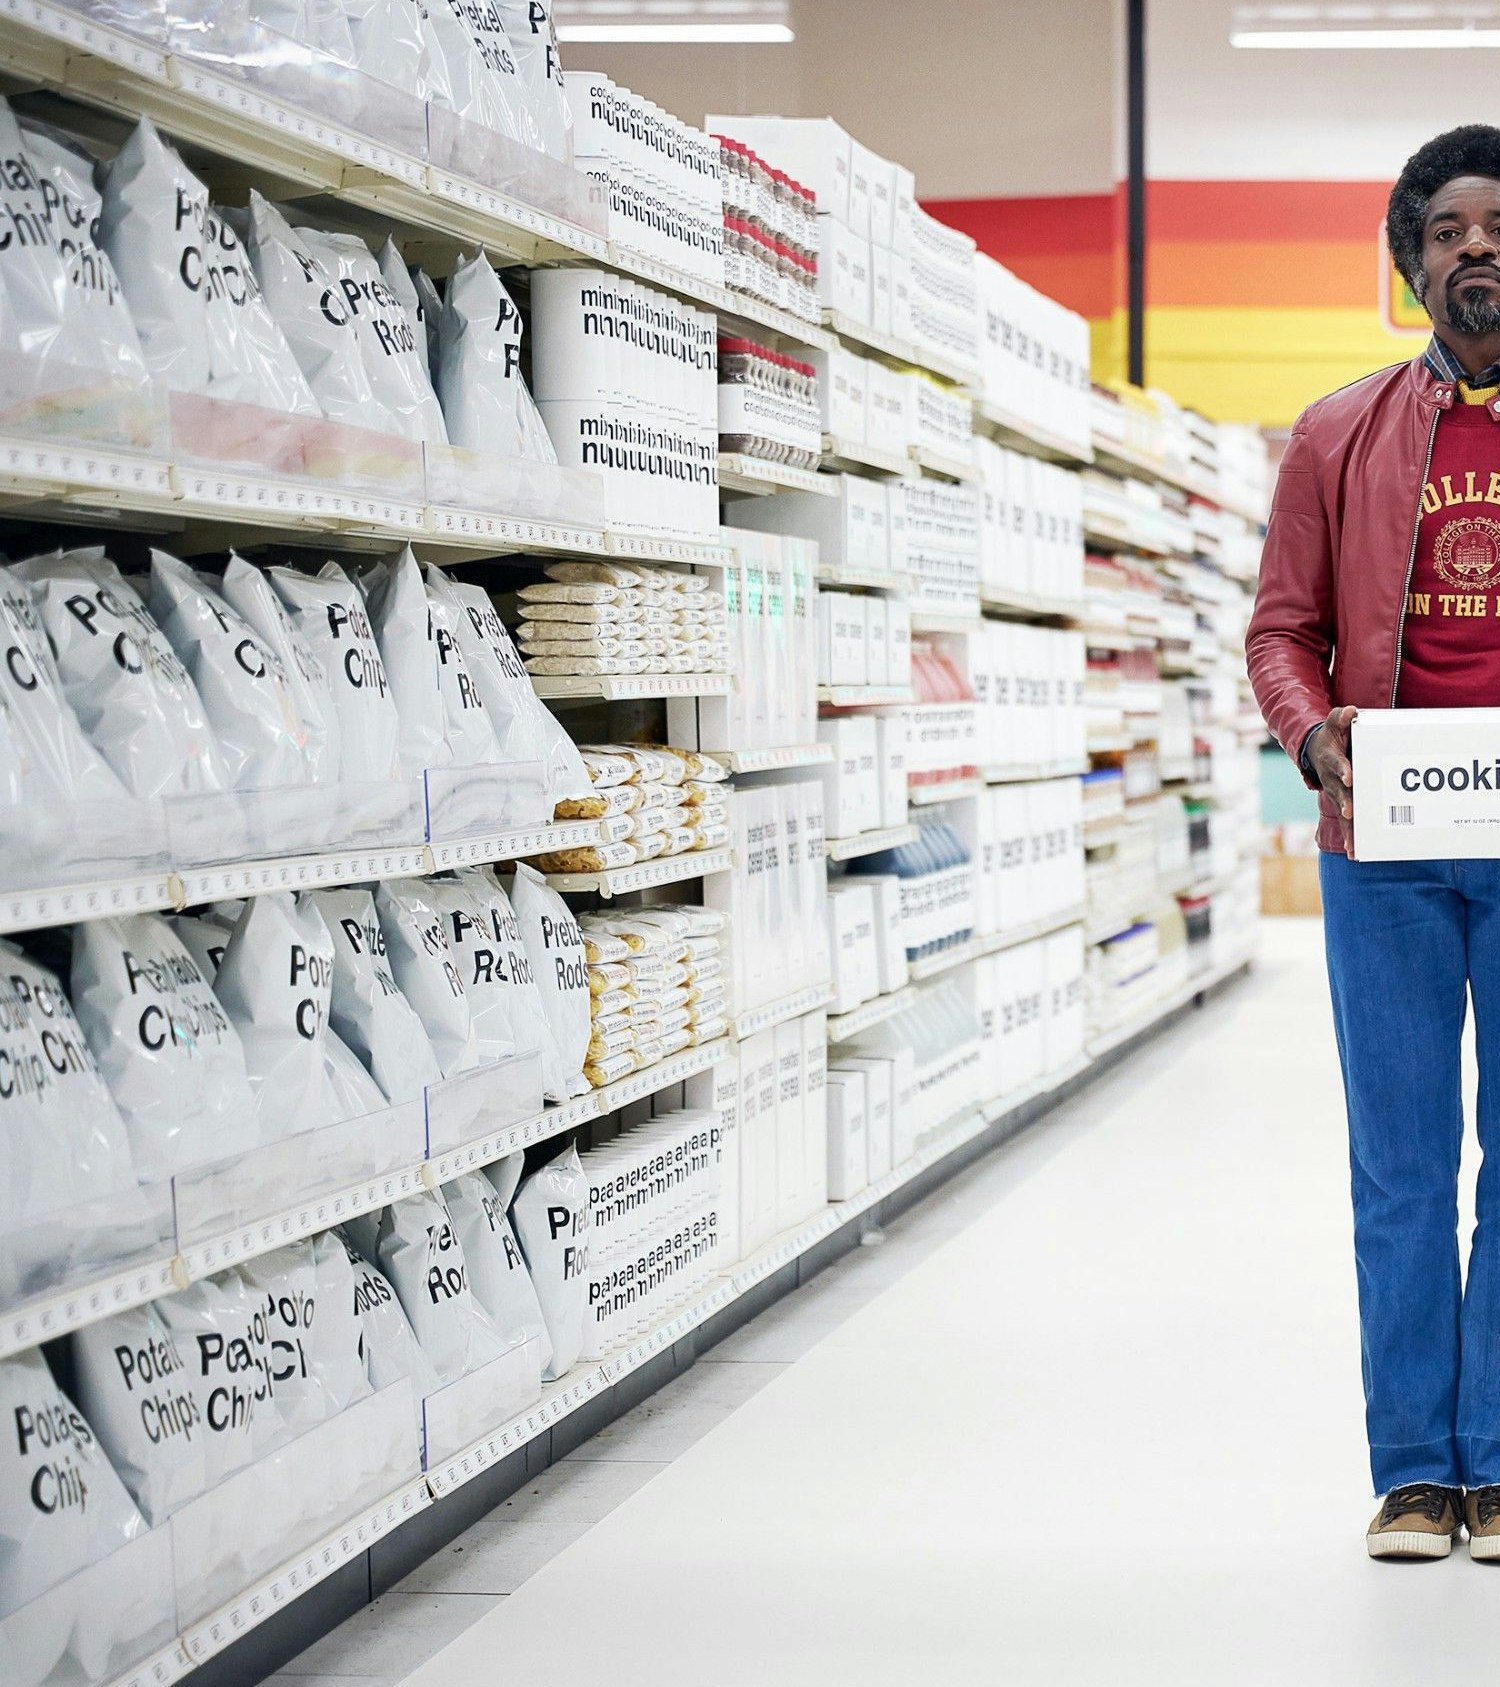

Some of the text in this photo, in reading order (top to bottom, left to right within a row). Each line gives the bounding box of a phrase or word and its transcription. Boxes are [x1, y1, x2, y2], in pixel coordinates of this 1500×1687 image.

[1442, 526, 1464, 564] COLLEGE
[1466, 523, 1481, 531] ON
[1484, 525, 1500, 541] THE
[1439, 594, 1487, 617] THE
